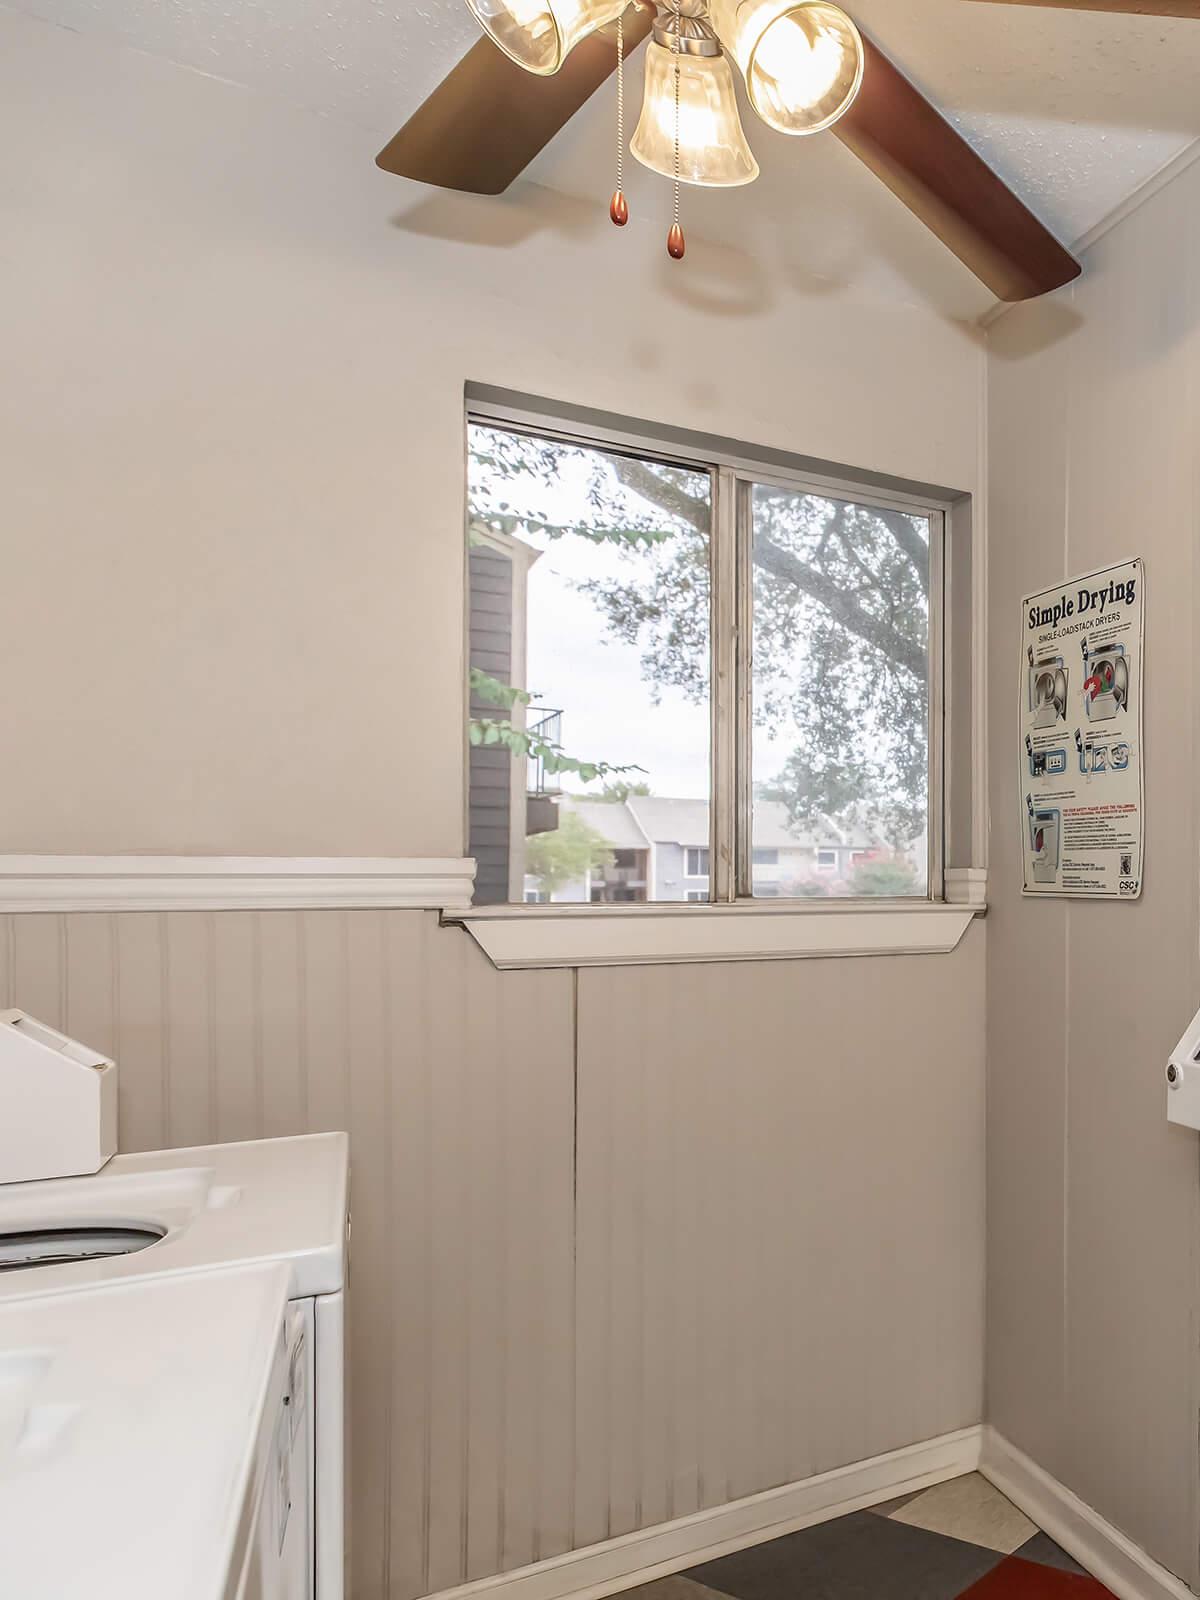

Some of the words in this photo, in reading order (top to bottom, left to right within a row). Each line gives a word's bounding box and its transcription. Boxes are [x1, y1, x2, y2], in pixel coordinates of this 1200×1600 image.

[1028, 595, 1074, 629] Simple
[1078, 580, 1136, 613] Drying
[1096, 612, 1121, 626] DRYERS
[1120, 881, 1134, 889] CSC
